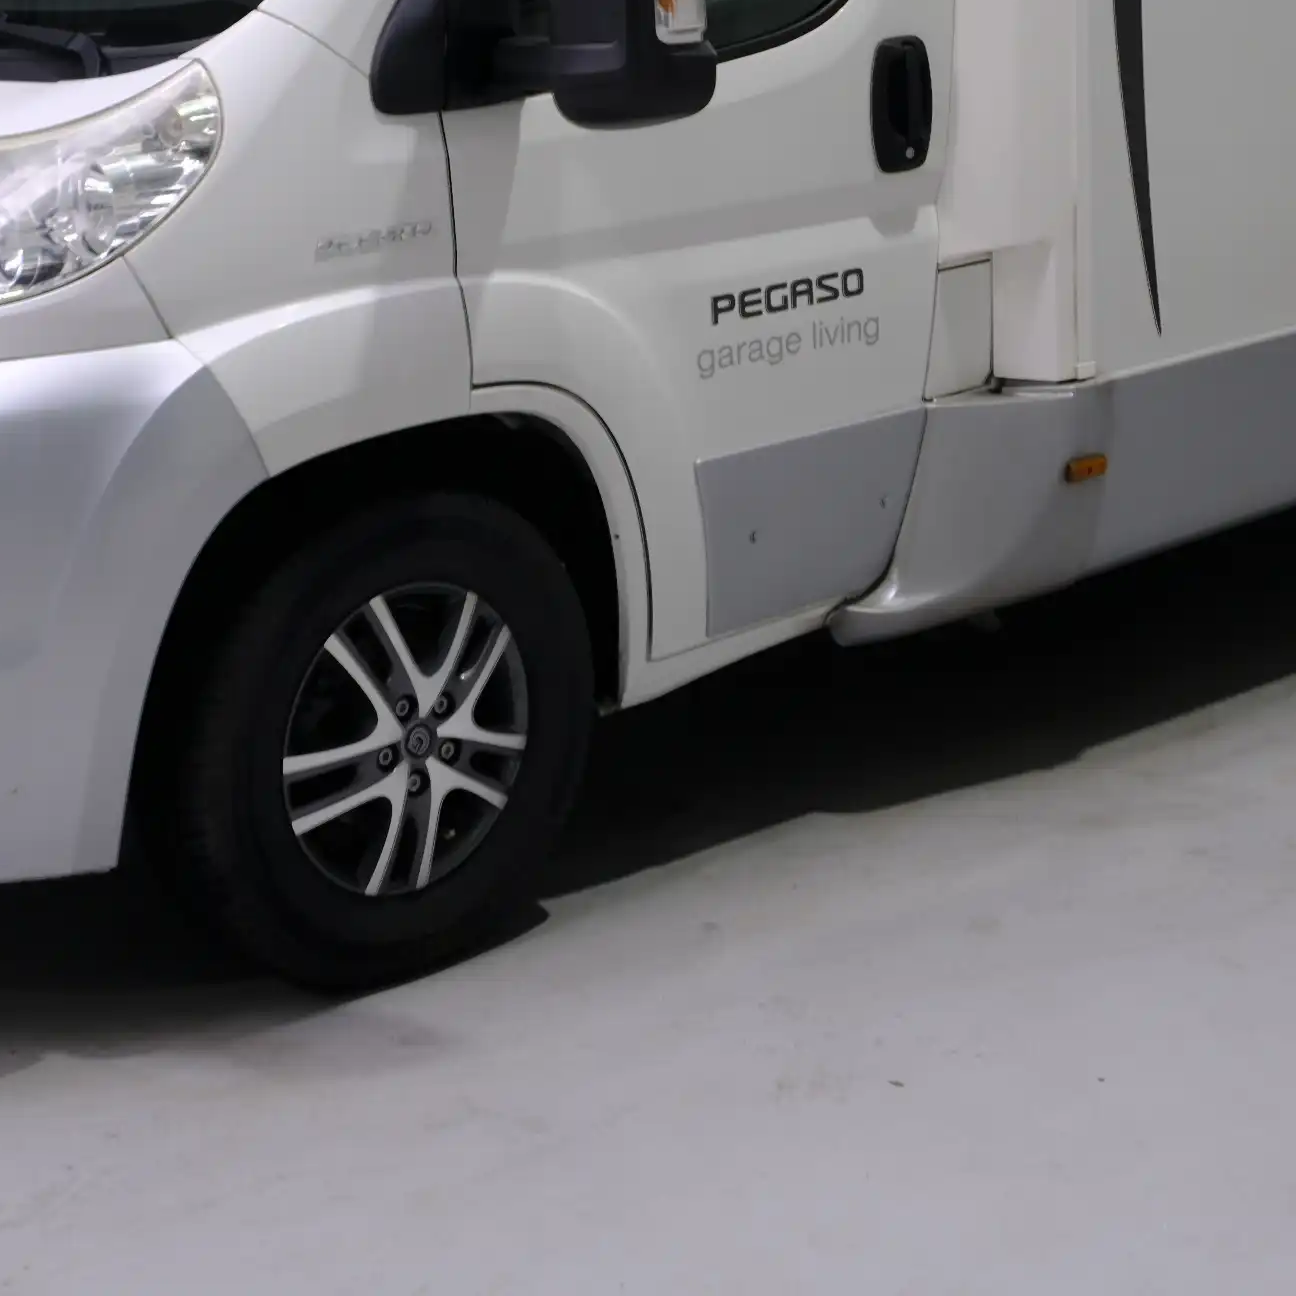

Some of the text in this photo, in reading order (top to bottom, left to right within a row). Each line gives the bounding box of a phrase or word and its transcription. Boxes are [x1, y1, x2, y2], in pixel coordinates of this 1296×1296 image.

[710, 267, 865, 326] PEGASO
[696, 315, 881, 380] garage living
